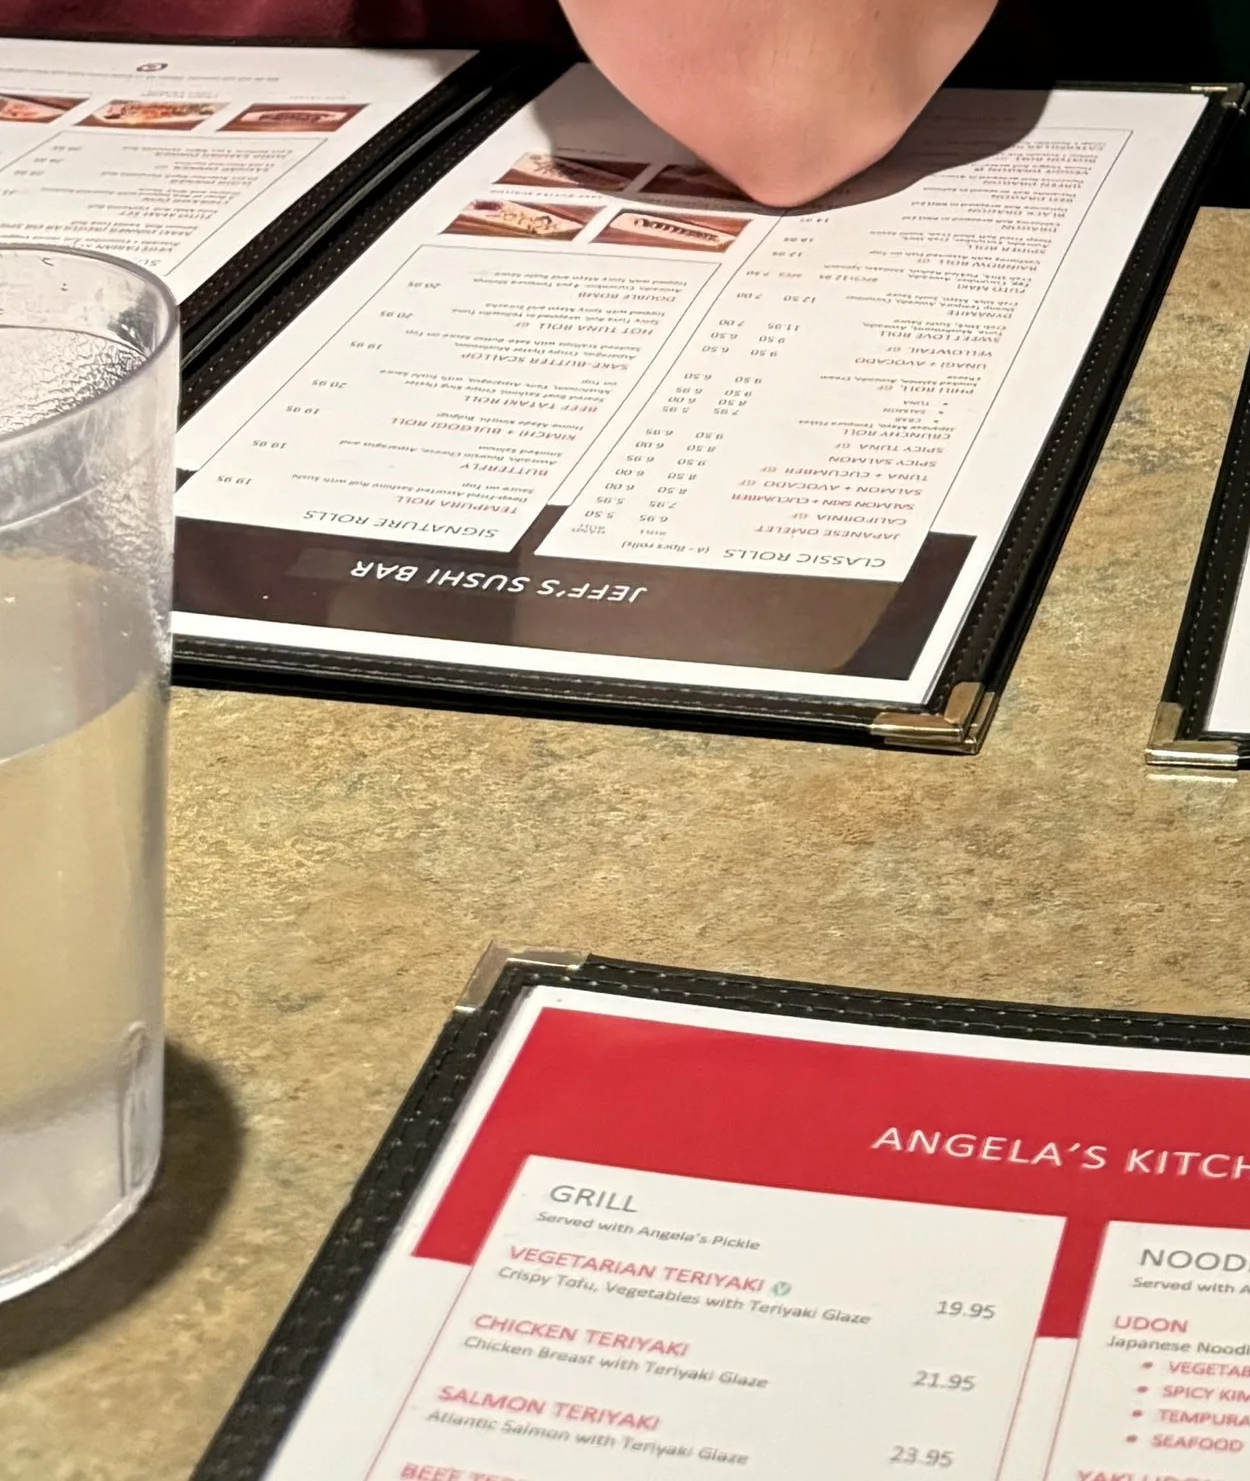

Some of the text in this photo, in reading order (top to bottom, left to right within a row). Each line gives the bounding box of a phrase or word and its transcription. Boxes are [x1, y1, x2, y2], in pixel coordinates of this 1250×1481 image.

[303, 510, 499, 538] SIGNATURE ROLLS
[723, 549, 886, 568] CLASSIC ROLLS
[350, 561, 648, 604] JEFF'S SUSHI BAR
[871, 1127, 1107, 1169] ANGELA'S
[549, 1184, 638, 1213] GRILL
[536, 1211, 761, 1250] Served with Angela's Pickle
[510, 1245, 765, 1292] VEGETARIAN TERIYAKI
[497, 1266, 872, 1325] Crispy Tofu, Vegetables with Teriyaki Glaze
[1131, 1276, 1193, 1291] Served
[1196, 1282, 1235, 1293] with
[936, 1300, 996, 1320] 19.95
[473, 1313, 689, 1357] CHICKEN TERIYAKI
[1113, 1315, 1188, 1334] UDON
[1106, 1335, 1191, 1352] Japanese
[463, 1335, 769, 1388] Chicken Breast with Teriyaki Glaze
[912, 1370, 976, 1392] 21.95
[1162, 1384, 1215, 1400] SPICY
[437, 1385, 660, 1431] SALMON TERIYAKI
[425, 1410, 749, 1465] Atlantic Salmon with Teriyaki Glaze
[1151, 1433, 1244, 1453] SEAFOOD
[888, 1445, 954, 1468] 23.95
